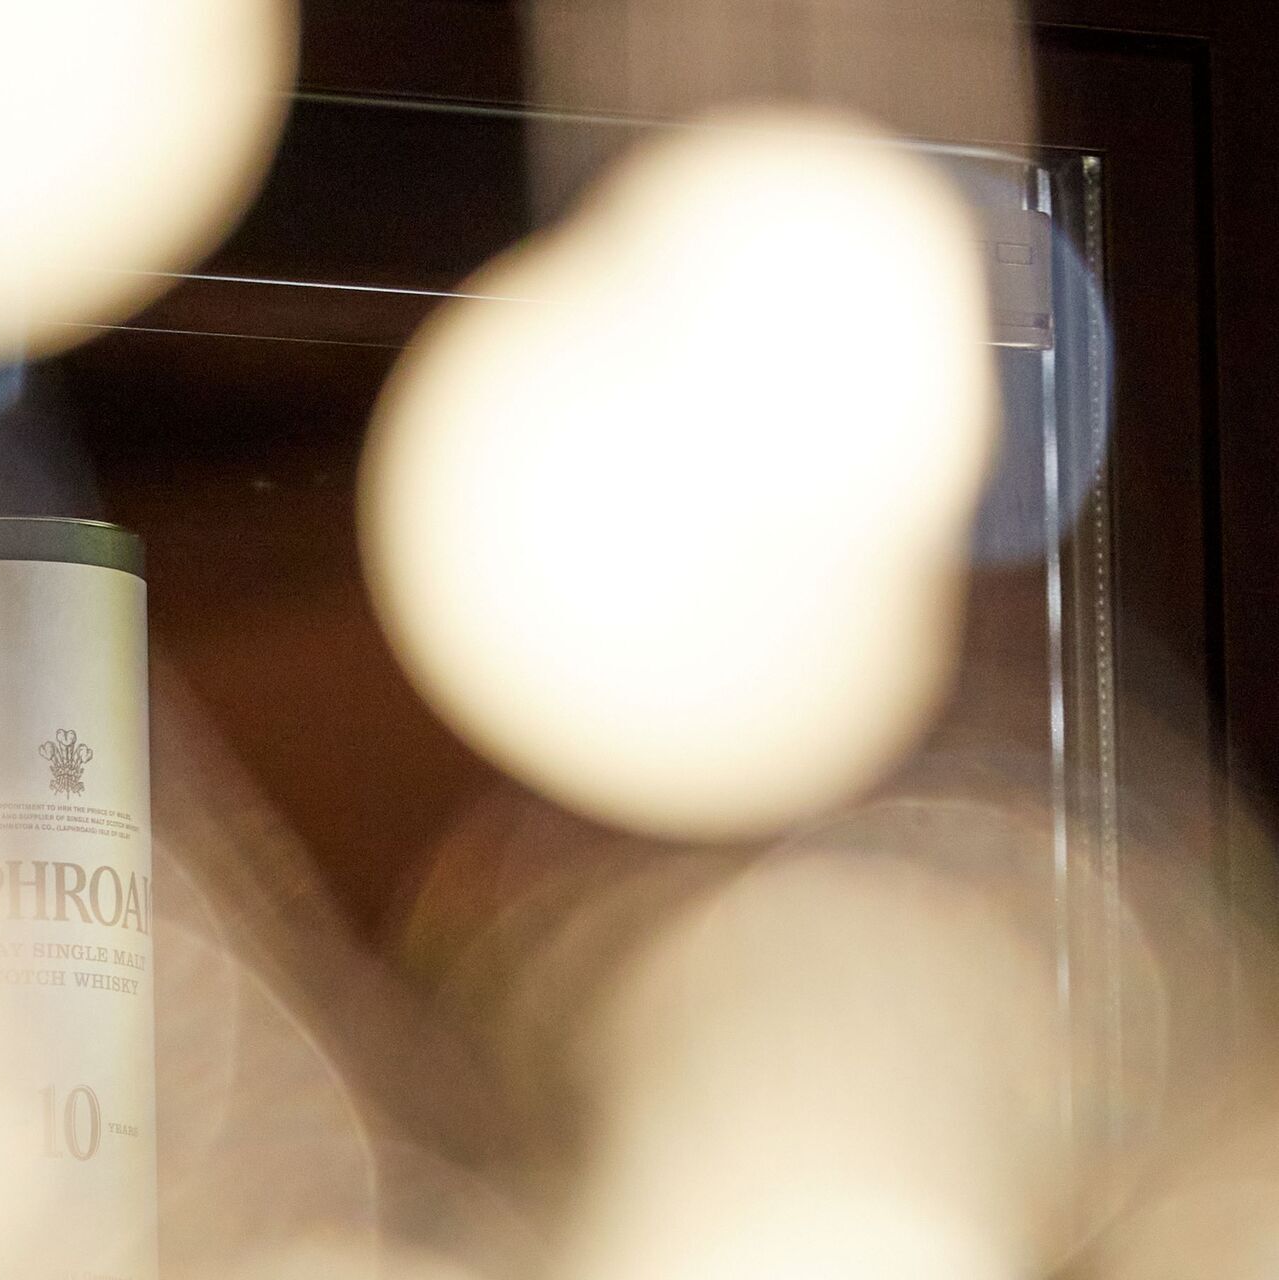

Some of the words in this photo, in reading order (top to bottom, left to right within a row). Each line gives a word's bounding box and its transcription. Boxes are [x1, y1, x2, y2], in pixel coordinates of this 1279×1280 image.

[32, 943, 108, 963] SINGLE
[113, 948, 147, 972] MALT
[74, 970, 140, 997] WHISKY
[37, 1083, 102, 1163] 10
[107, 1121, 139, 1138] YEARS
